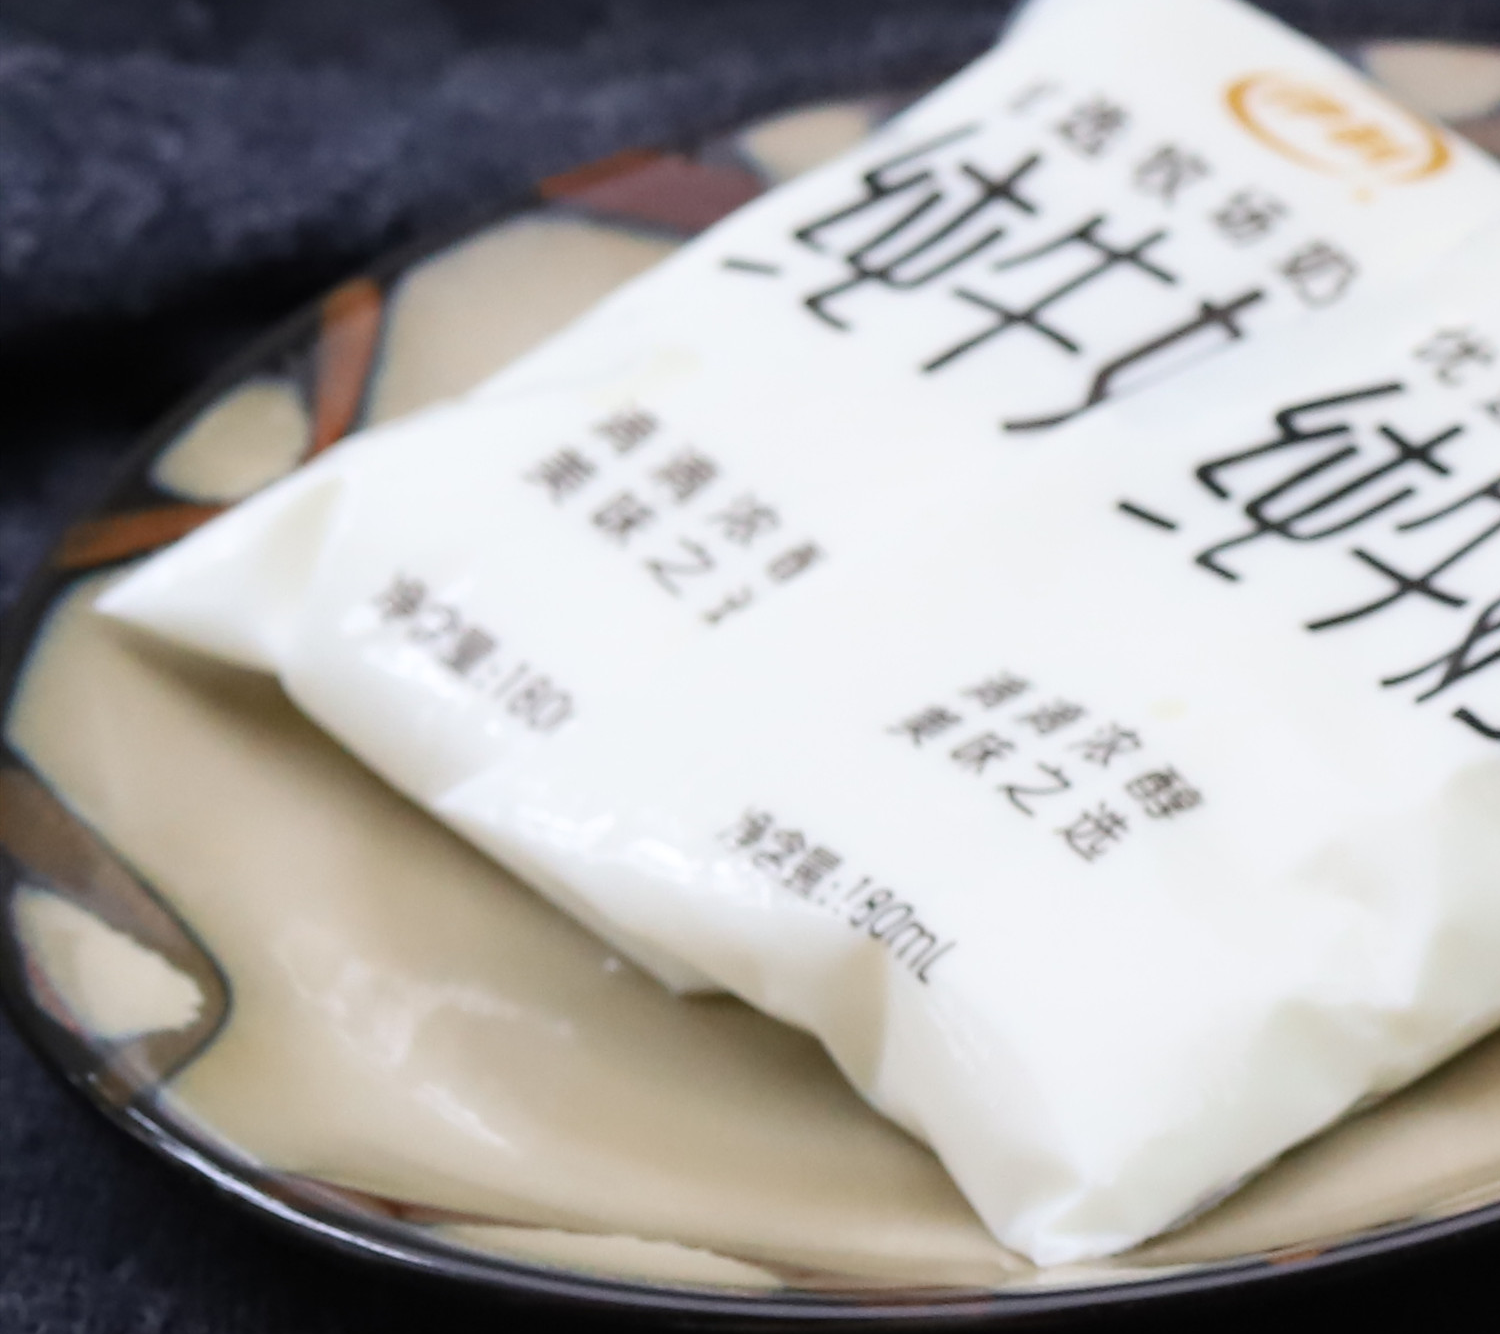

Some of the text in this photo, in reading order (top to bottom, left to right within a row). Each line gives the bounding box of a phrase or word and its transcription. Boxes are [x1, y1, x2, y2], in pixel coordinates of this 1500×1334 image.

[721, 123, 1266, 432] 纯牛
[886, 703, 1135, 864] 美味之选
